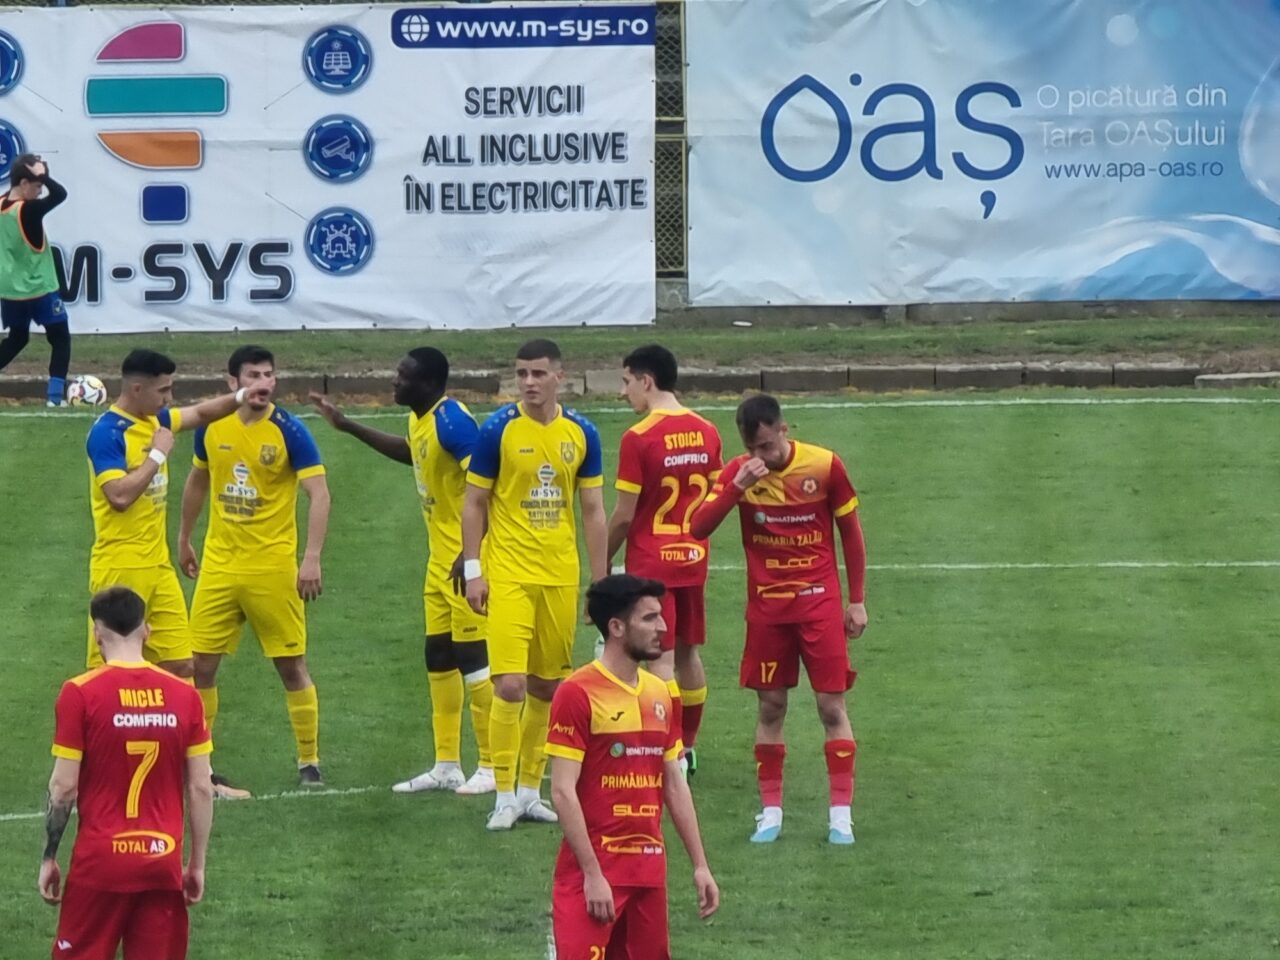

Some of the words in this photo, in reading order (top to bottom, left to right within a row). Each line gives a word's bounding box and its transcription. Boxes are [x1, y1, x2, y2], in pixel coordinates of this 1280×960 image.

[436, 18, 649, 42] www.m-sys.ro
[464, 85, 584, 117] SERVICII
[1037, 84, 1060, 108] O
[1068, 84, 1177, 115] picătură
[1186, 83, 1227, 107] din
[422, 135, 472, 165] ALL
[480, 132, 627, 164] INCLUSIVE
[1045, 161, 1224, 182] www.apa-oas.ro
[403, 174, 433, 212] ÎN
[440, 179, 646, 212] ELECTRICITATE
[51, 241, 294, 303] M-SYS
[664, 431, 704, 450] STOICA
[653, 473, 709, 535] 22
[760, 661, 778, 684] 17
[119, 688, 165, 708] MICLE
[113, 713, 177, 728] COMFRIO
[126, 740, 160, 819] 7
[112, 840, 148, 854] TOTAL
[150, 839, 165, 853] AS
